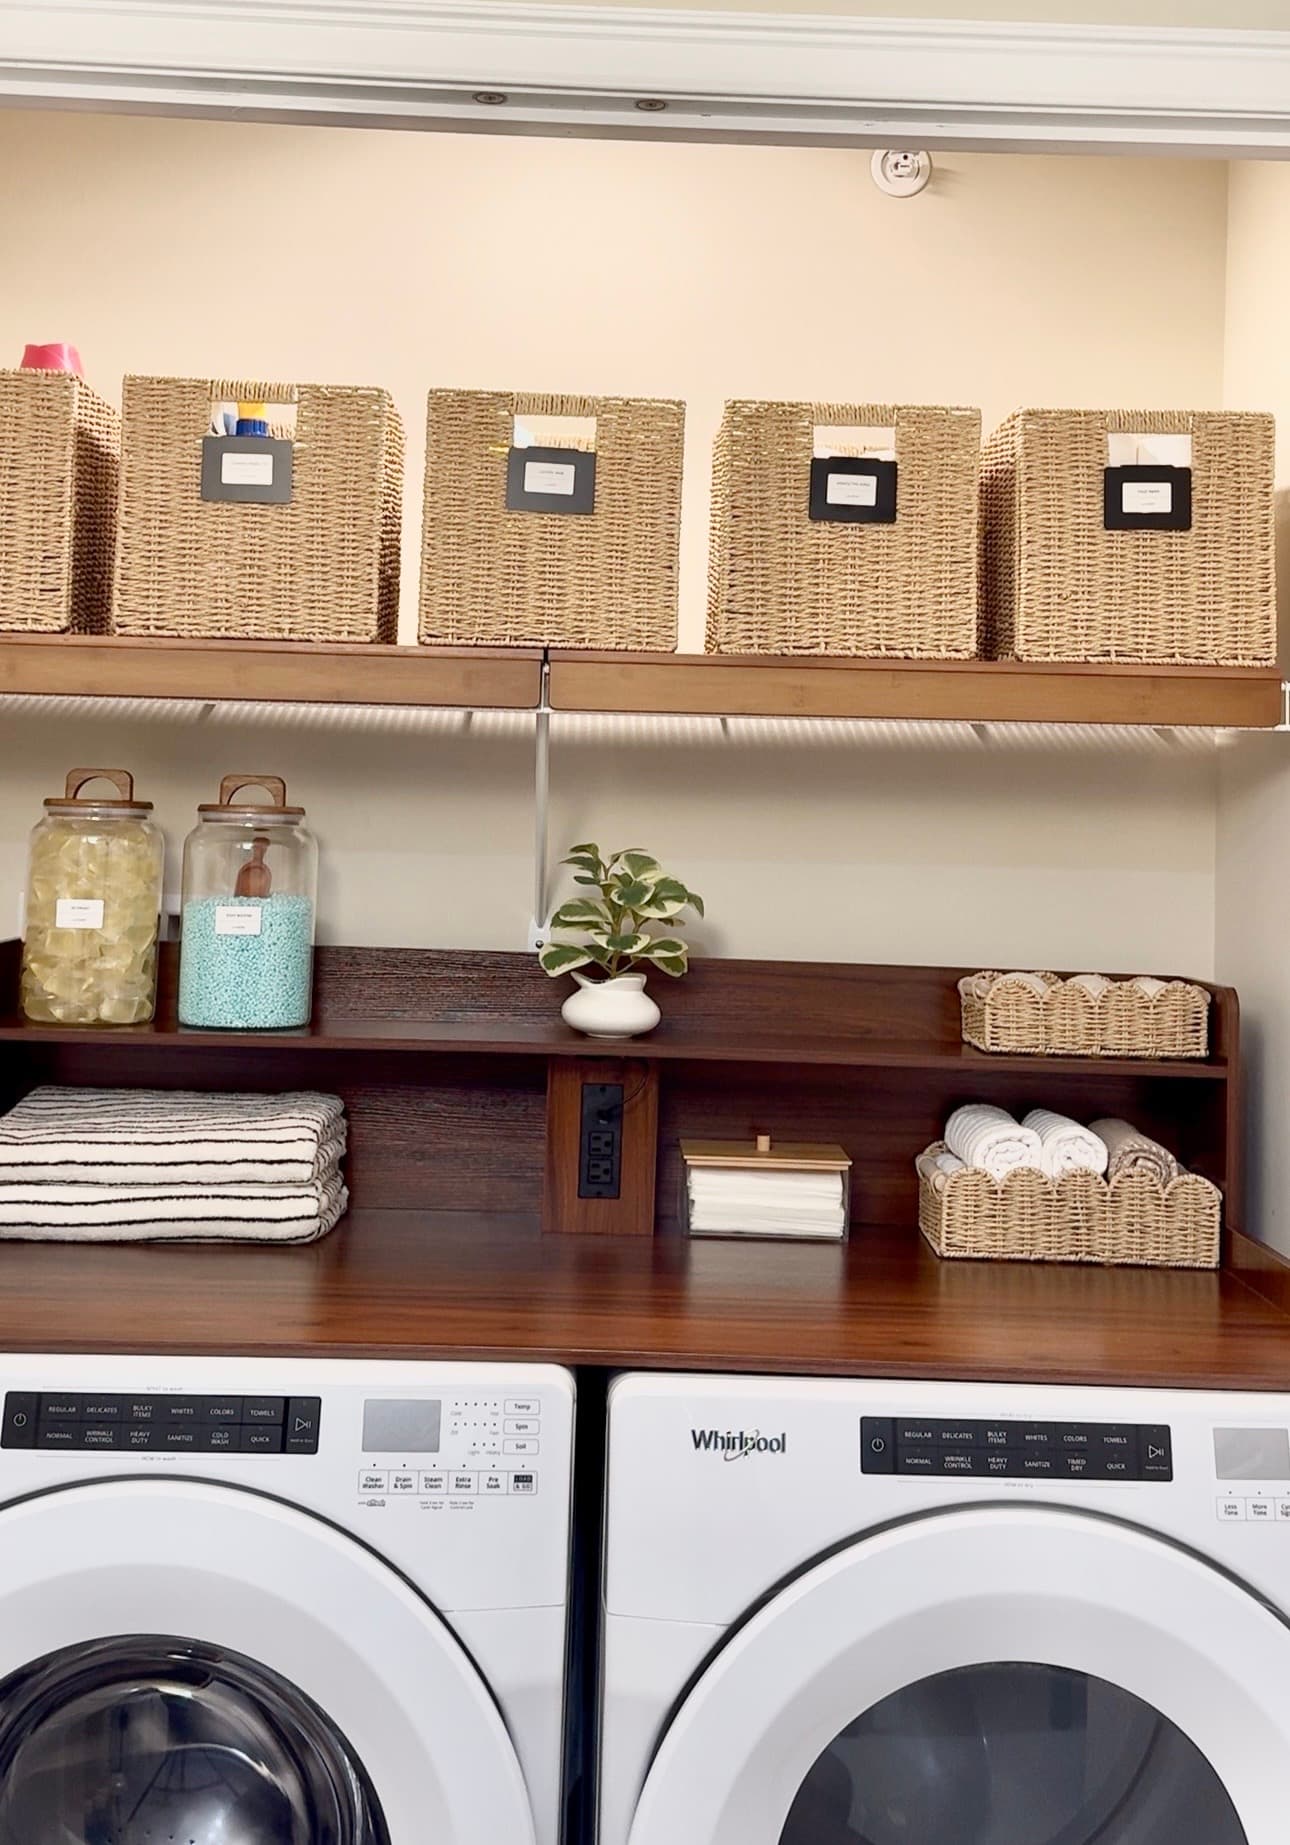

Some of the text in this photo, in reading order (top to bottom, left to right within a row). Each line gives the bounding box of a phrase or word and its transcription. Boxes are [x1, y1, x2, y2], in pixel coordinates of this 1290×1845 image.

[86, 1406, 118, 1414] DELICATES
[514, 1403, 531, 1411] Temp
[515, 1423, 529, 1431] Spin
[250, 1435, 270, 1443] QUICK
[691, 1429, 786, 1457] Whirlpool
[1103, 1436, 1127, 1444] TOWELS
[1024, 1460, 1050, 1468] SANITIZE
[1106, 1462, 1125, 1470] QUICK
